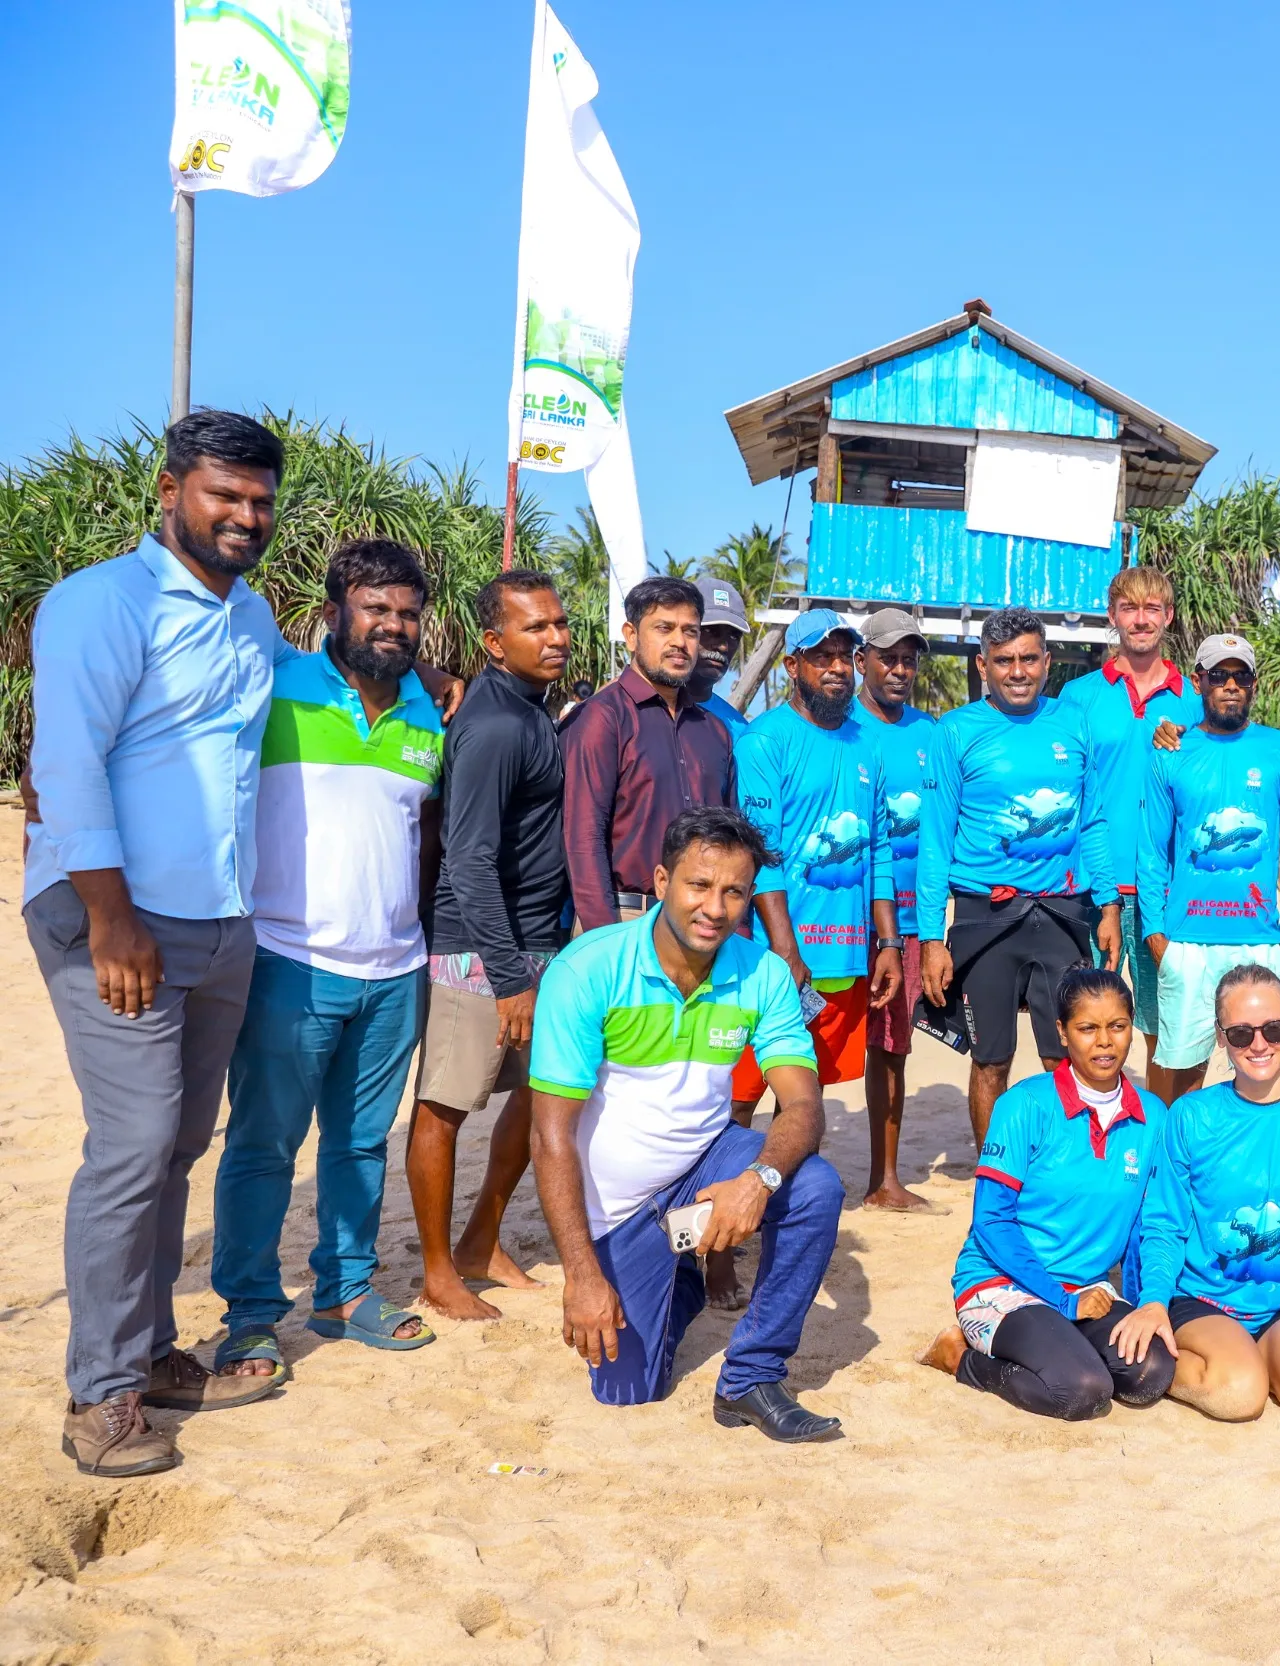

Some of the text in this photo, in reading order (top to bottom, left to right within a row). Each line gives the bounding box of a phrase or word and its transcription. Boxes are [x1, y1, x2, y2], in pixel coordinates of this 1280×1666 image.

[523, 409, 536, 419] SRI
[540, 411, 585, 427] LANKA
[544, 438, 567, 446] CEYLON
[520, 440, 565, 463] BOC
[1187, 908, 1256, 918] DIVE CENTER
[804, 935, 832, 945] DIVE
[981, 1142, 1006, 1159] ADI
